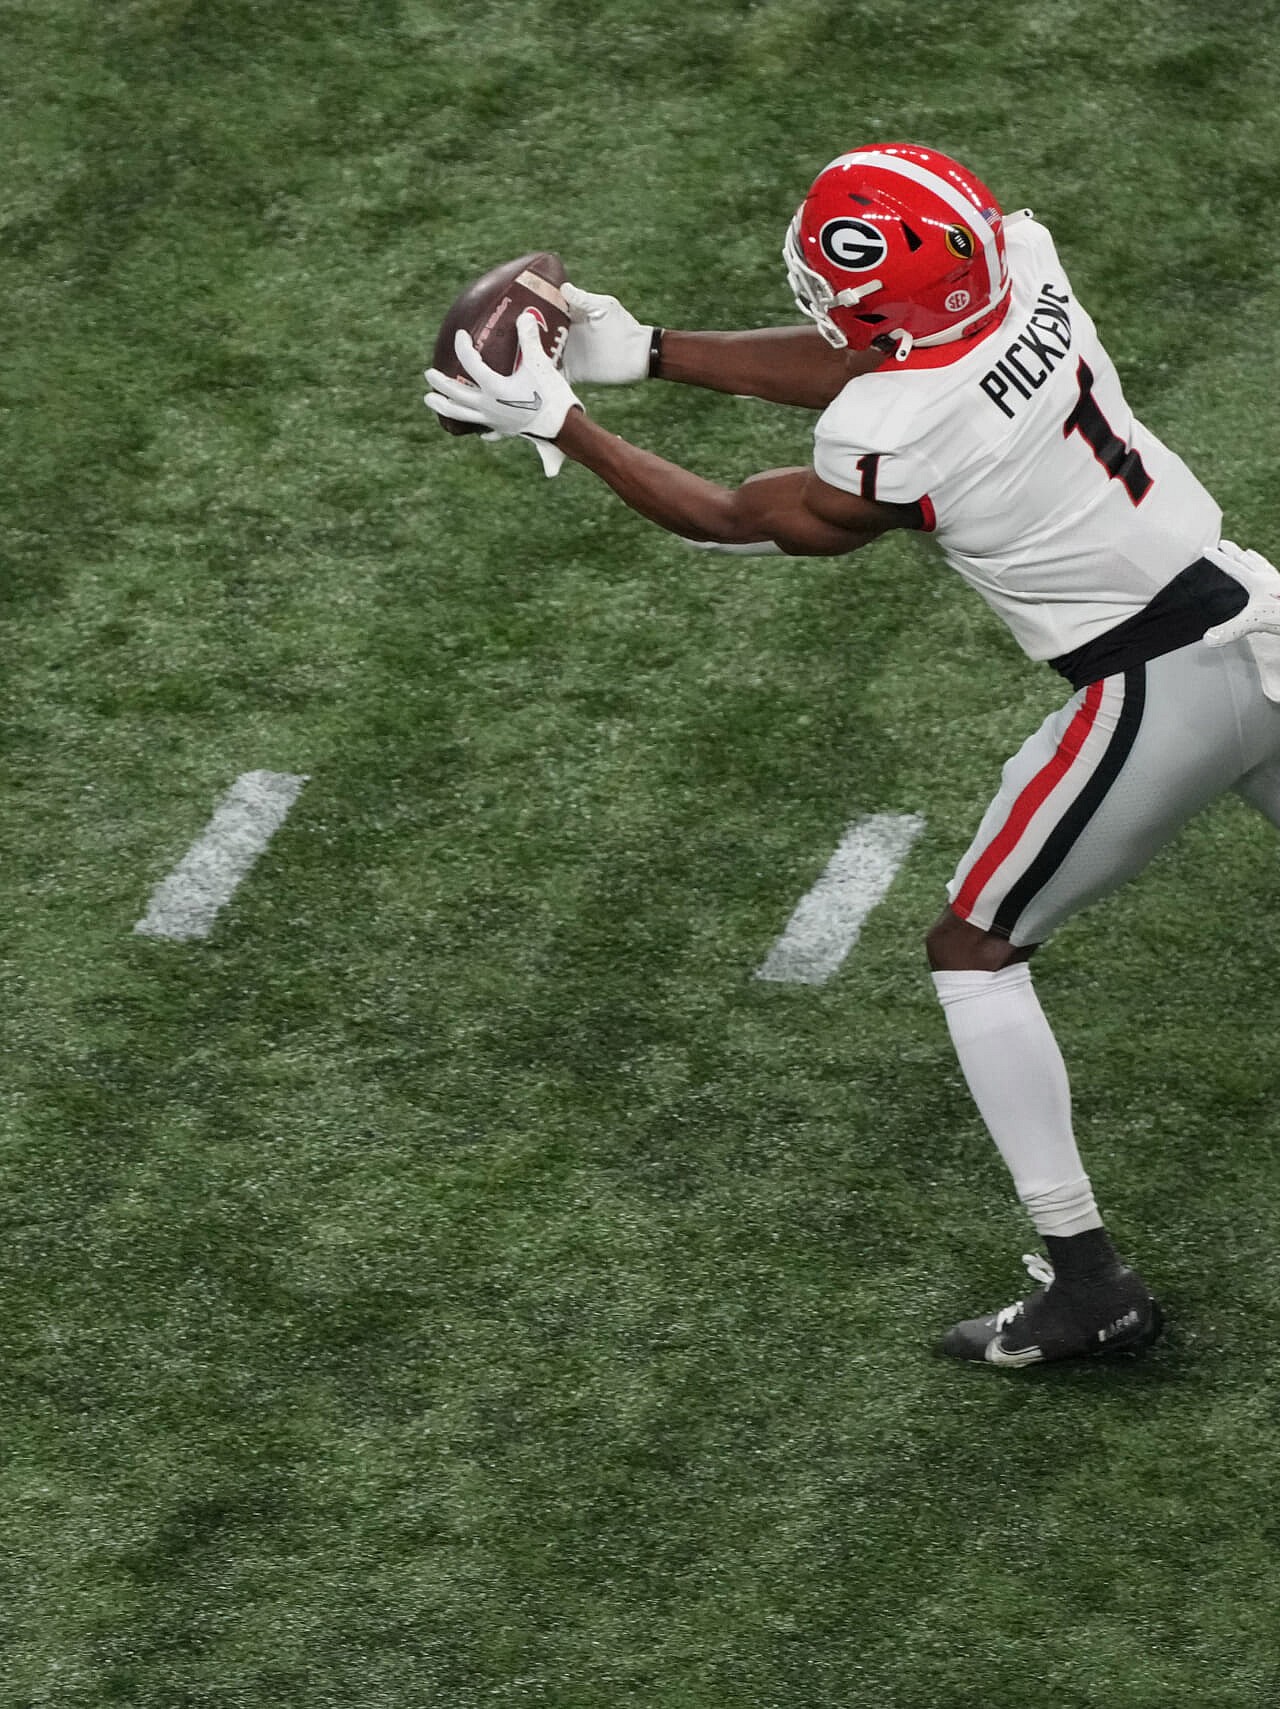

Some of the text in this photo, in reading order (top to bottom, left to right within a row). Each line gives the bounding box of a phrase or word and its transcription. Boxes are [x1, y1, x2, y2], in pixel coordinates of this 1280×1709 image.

[820, 217, 887, 271] G
[947, 292, 967, 309] SEC
[1063, 353, 1155, 508] 1
[855, 453, 881, 500] 1
